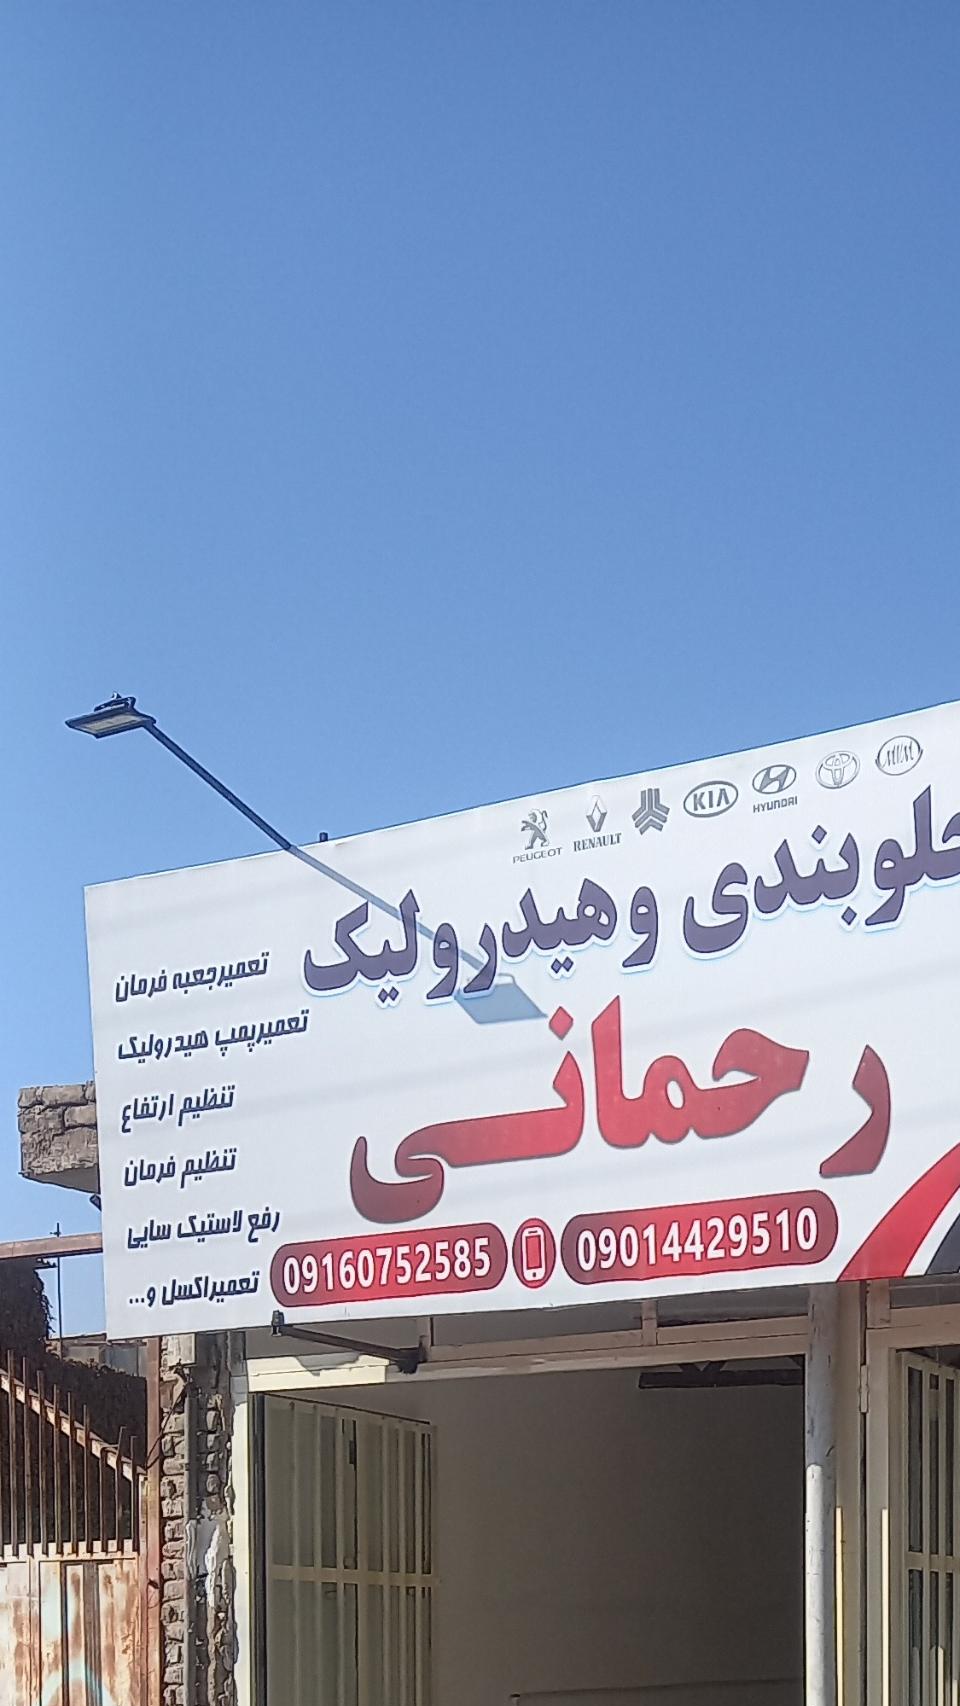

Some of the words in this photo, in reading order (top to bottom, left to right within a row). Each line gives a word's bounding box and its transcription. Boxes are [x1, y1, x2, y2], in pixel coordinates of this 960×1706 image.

[692, 787, 730, 811] KIA
[752, 795, 798, 813] HYUNDAI
[512, 847, 563, 864] PEUGEOT
[573, 832, 622, 853] RENAULT
[115, 969, 167, 1002] فرمان
[118, 1030, 209, 1064] هیدرولیک
[121, 1093, 175, 1133] ارتفاع
[178, 1084, 236, 1126] تنظیم
[350, 995, 891, 1223] رحمانی
[124, 1155, 176, 1187] فرمان
[180, 1147, 237, 1188] تنظیم
[177, 1209, 243, 1242] لاستیک
[248, 1206, 280, 1242] رفع
[577, 1208, 818, 1270] 09014429510
[283, 1238, 491, 1294] 09160752585
